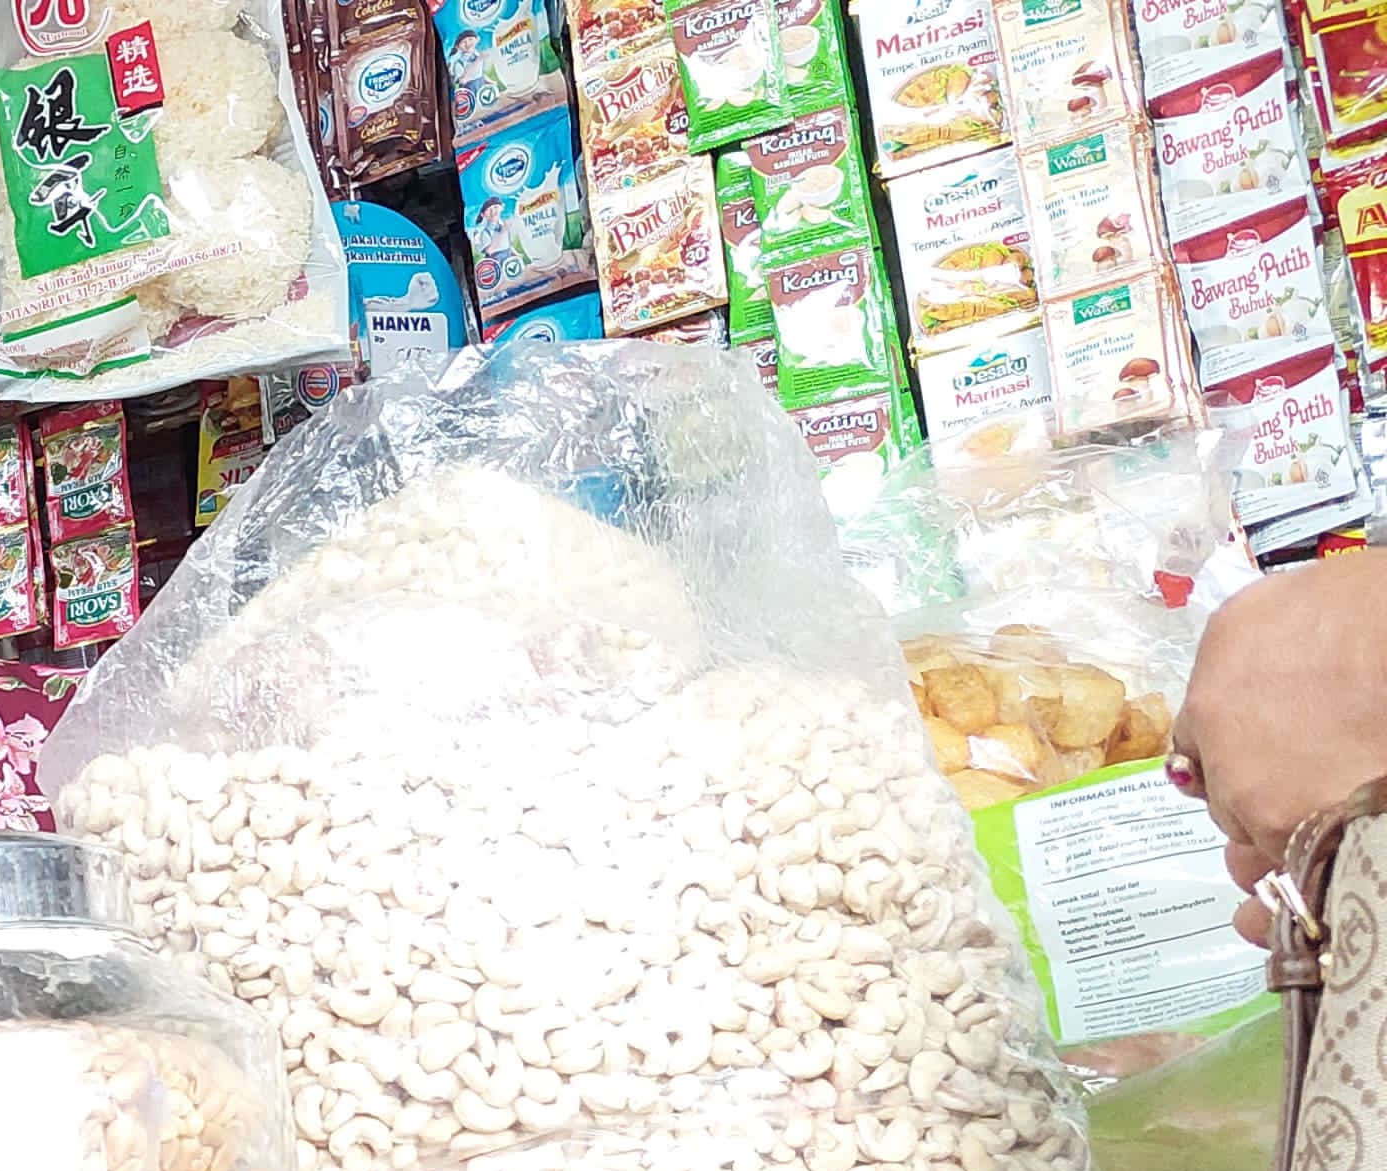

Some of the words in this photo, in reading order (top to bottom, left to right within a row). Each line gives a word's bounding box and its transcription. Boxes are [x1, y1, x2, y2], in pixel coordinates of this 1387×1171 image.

[683, 2, 755, 38] Kating
[1183, 2, 1228, 30] Bubuk
[501, 32, 533, 56] VANILLA
[875, 8, 985, 60] Marinasi
[956, 37, 988, 57] Ayam
[115, 34, 159, 98] 精选
[669, 116, 689, 133] 30
[1162, 120, 1234, 166] Bawang
[1233, 100, 1284, 136] Putih
[759, 124, 836, 155] Kating
[16, 67, 112, 248] 银耳
[1202, 145, 1250, 175] Bubuk
[523, 208, 557, 227] VANILLA
[735, 206, 759, 228] Ka
[926, 196, 1003, 231] Marinasi
[351, 234, 377, 248] Akal
[378, 234, 424, 248] Cermat
[345, 250, 375, 264] gkan
[684, 247, 707, 265] 30
[56, 270, 90, 291] Brand
[781, 264, 859, 294] Kating
[1191, 266, 1259, 311] Bawang
[1258, 245, 1312, 283] Putih
[58, 293, 74, 308] PL
[1228, 291, 1275, 320] Bubuk
[371, 315, 432, 332] HANYA
[753, 349, 777, 369] Ka
[952, 356, 1028, 391] Desaku
[955, 375, 1033, 408] Marinasi
[798, 411, 877, 439] Kating
[1282, 393, 1335, 428] Putih
[1254, 437, 1299, 466] Bubuk
[69, 593, 118, 617] SAORI
[1050, 788, 1117, 810] INFORMASI
[1118, 780, 1151, 797] NILAI
